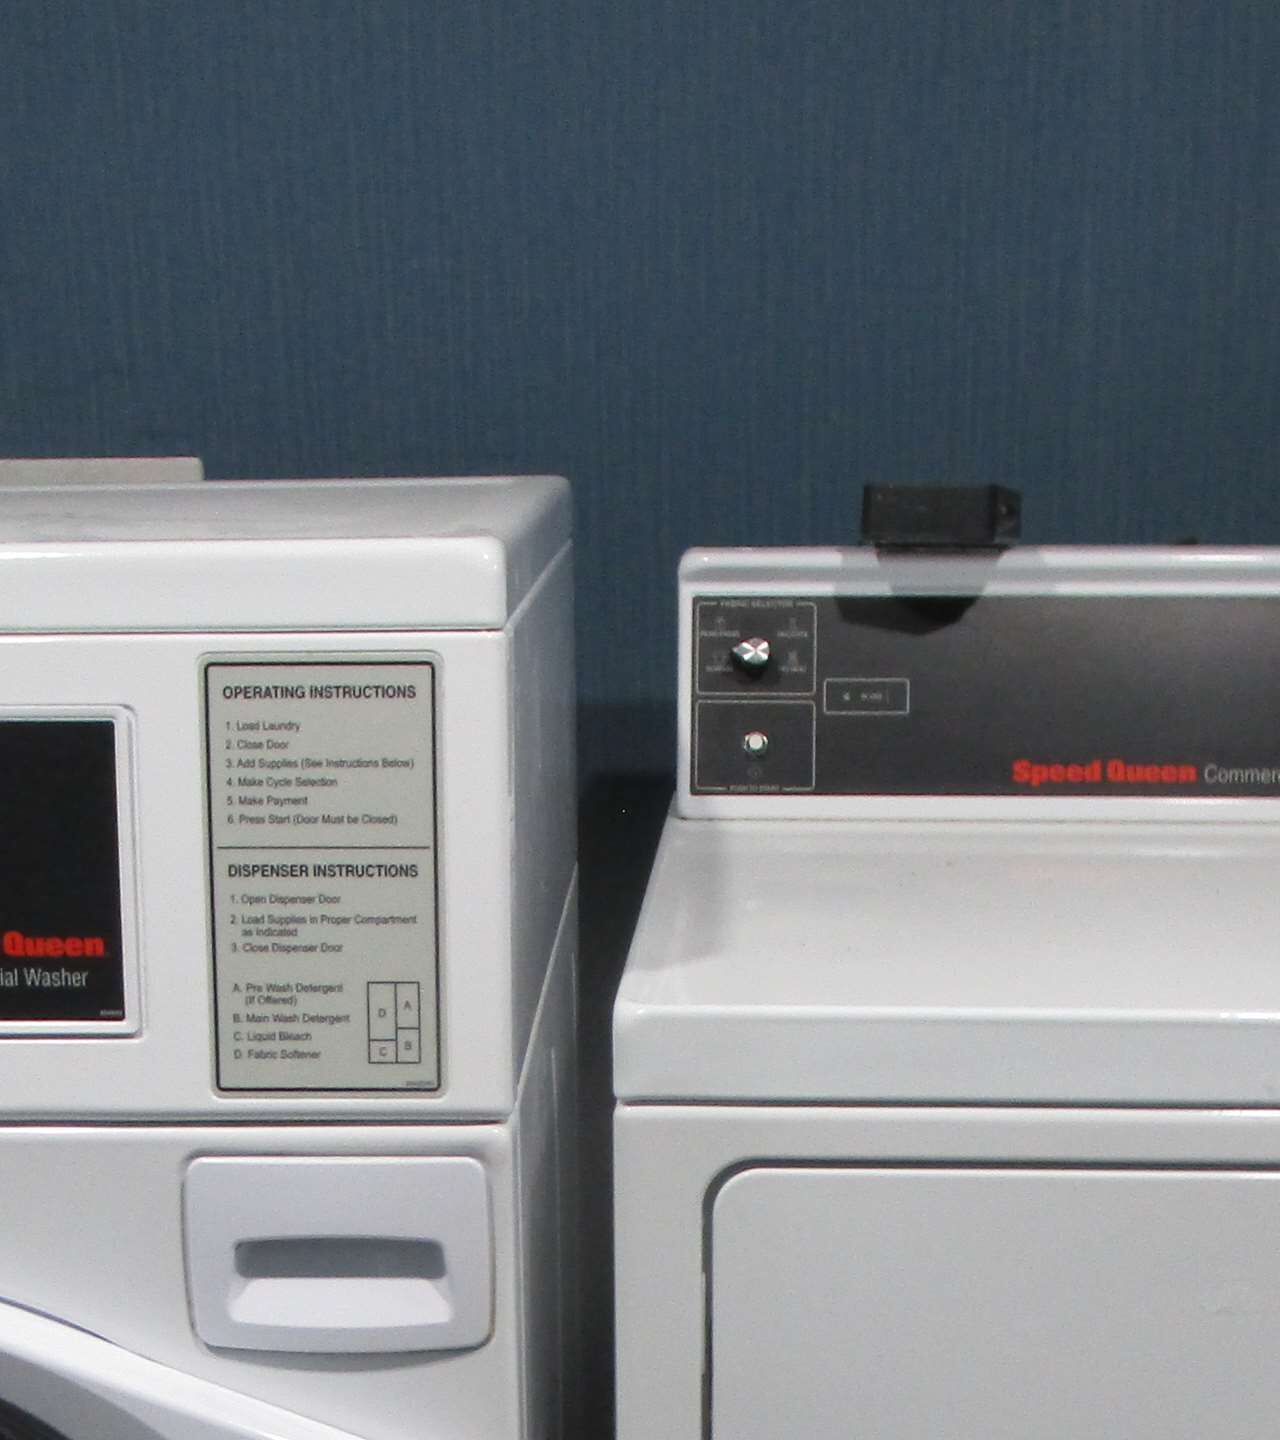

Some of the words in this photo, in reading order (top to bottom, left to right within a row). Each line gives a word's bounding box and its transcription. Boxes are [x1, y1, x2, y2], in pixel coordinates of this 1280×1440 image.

[222, 686, 306, 700] OPERATING
[309, 684, 417, 699] INSTRUCTIONS
[236, 720, 260, 731] Load
[262, 720, 301, 733] Laundry
[237, 740, 263, 750] Close
[266, 740, 289, 750] Door
[237, 759, 256, 769] Add
[258, 759, 298, 770] Supplies
[301, 759, 323, 770] (See
[325, 758, 379, 769] Instructions
[382, 757, 415, 770] Below)
[1012, 759, 1102, 787] Speed
[1107, 759, 1198, 784] Queen
[238, 777, 264, 787] Make
[266, 777, 293, 789] Cycle
[295, 777, 338, 788] Selection
[238, 796, 264, 806] Make
[266, 795, 308, 807] Payment
[239, 814, 265, 825] Press
[268, 814, 290, 825] Start
[292, 814, 319, 826] (Door
[321, 814, 345, 825] Must
[347, 814, 359, 825] be
[361, 814, 398, 826] Closed)
[228, 865, 309, 878] DISPENSER
[313, 864, 419, 878] INSTRUCTIONS
[241, 894, 267, 906] Open
[269, 894, 316, 906] Dispenser
[319, 893, 341, 904] Door
[241, 914, 265, 924] Load
[267, 914, 307, 926] Supplies
[320, 914, 352, 926] Proper
[354, 914, 417, 926] Compartment
[241, 928, 253, 937] as
[3, 931, 105, 957] Queen
[242, 942, 269, 952] Close
[271, 942, 318, 954] Dispenser
[320, 942, 343, 952] Door
[23, 967, 89, 987] Washer
[245, 983, 263, 993] Pre
[266, 983, 293, 993] Wash
[296, 983, 343, 995] Detergent
[257, 995, 298, 1007] Offered)
[404, 1000, 412, 1011] A
[378, 1007, 387, 1018] D
[246, 1013, 269, 1023] Main
[272, 1013, 299, 1023] Wash
[302, 1013, 350, 1025] Detergent
[247, 1031, 276, 1042] Liquid
[279, 1031, 312, 1041] Bleach
[404, 1040, 412, 1051] B
[247, 1049, 277, 1059] Fabric
[280, 1049, 321, 1060] Softener
[379, 1047, 388, 1058] C
